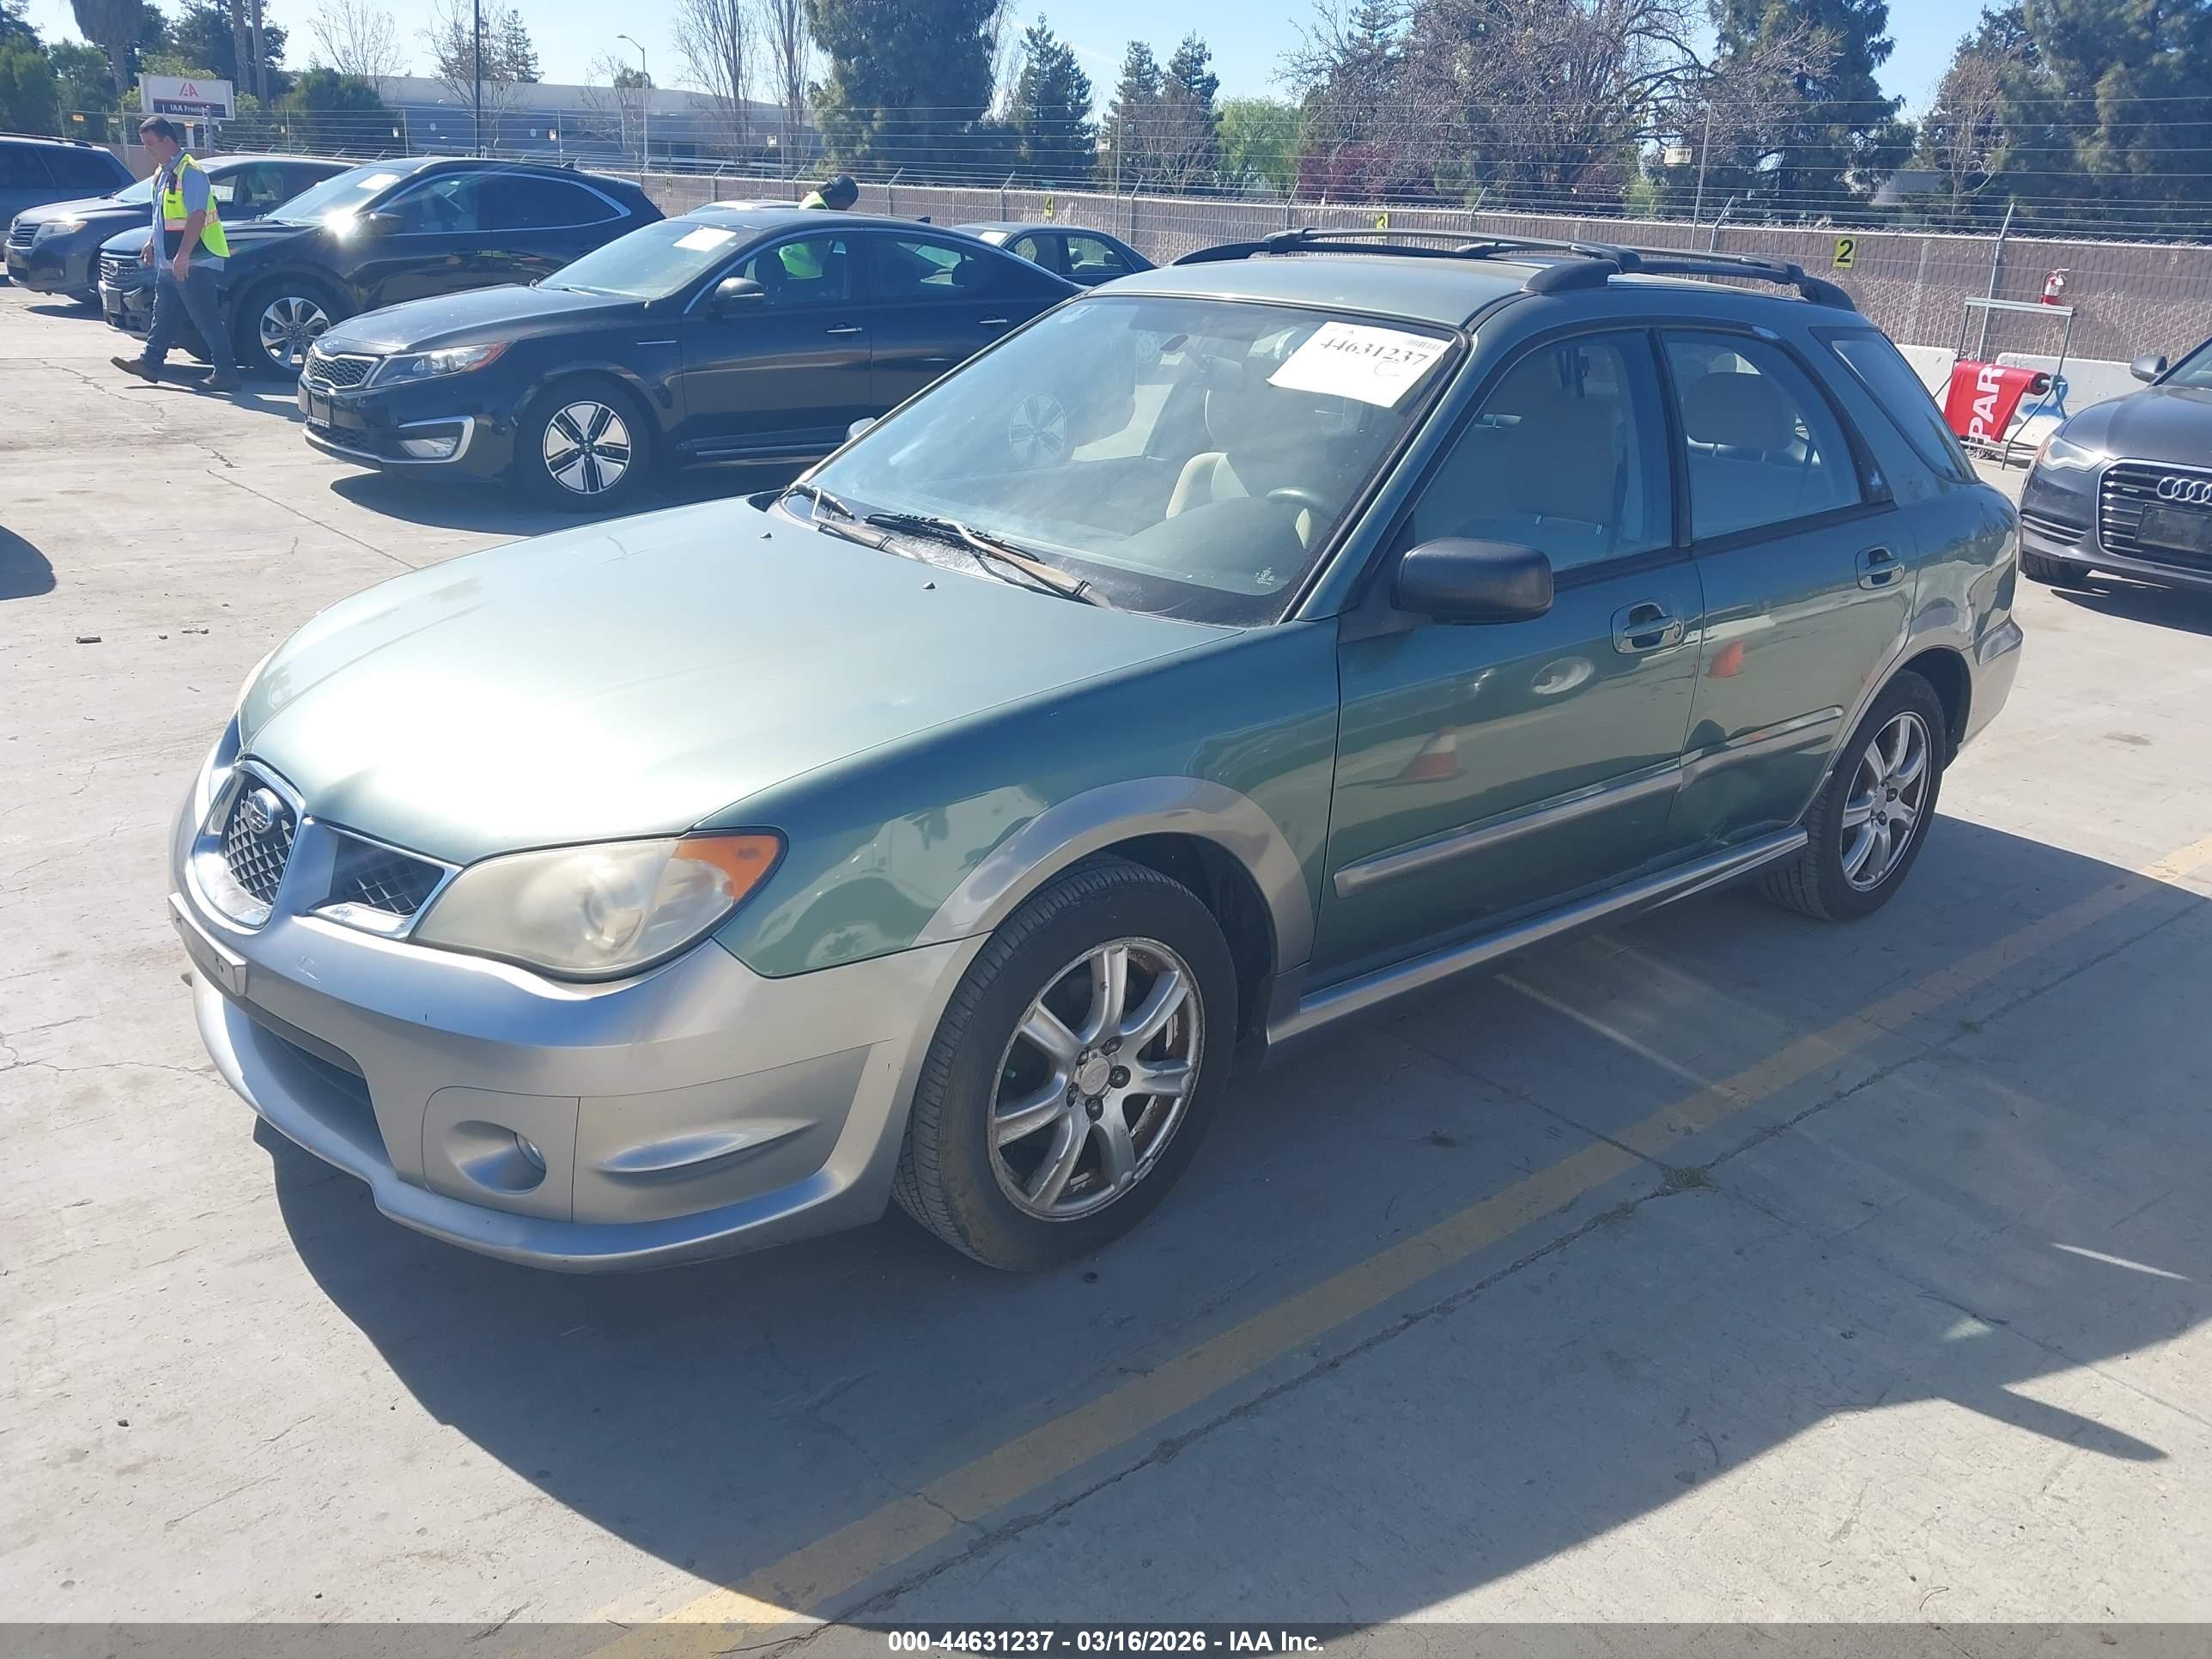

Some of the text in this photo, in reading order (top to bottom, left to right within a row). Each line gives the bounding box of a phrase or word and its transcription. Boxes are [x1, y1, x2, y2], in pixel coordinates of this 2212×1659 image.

[1045, 198, 1052, 213] 4
[1836, 239, 1854, 263] 2
[1321, 337, 1429, 366] 44631237
